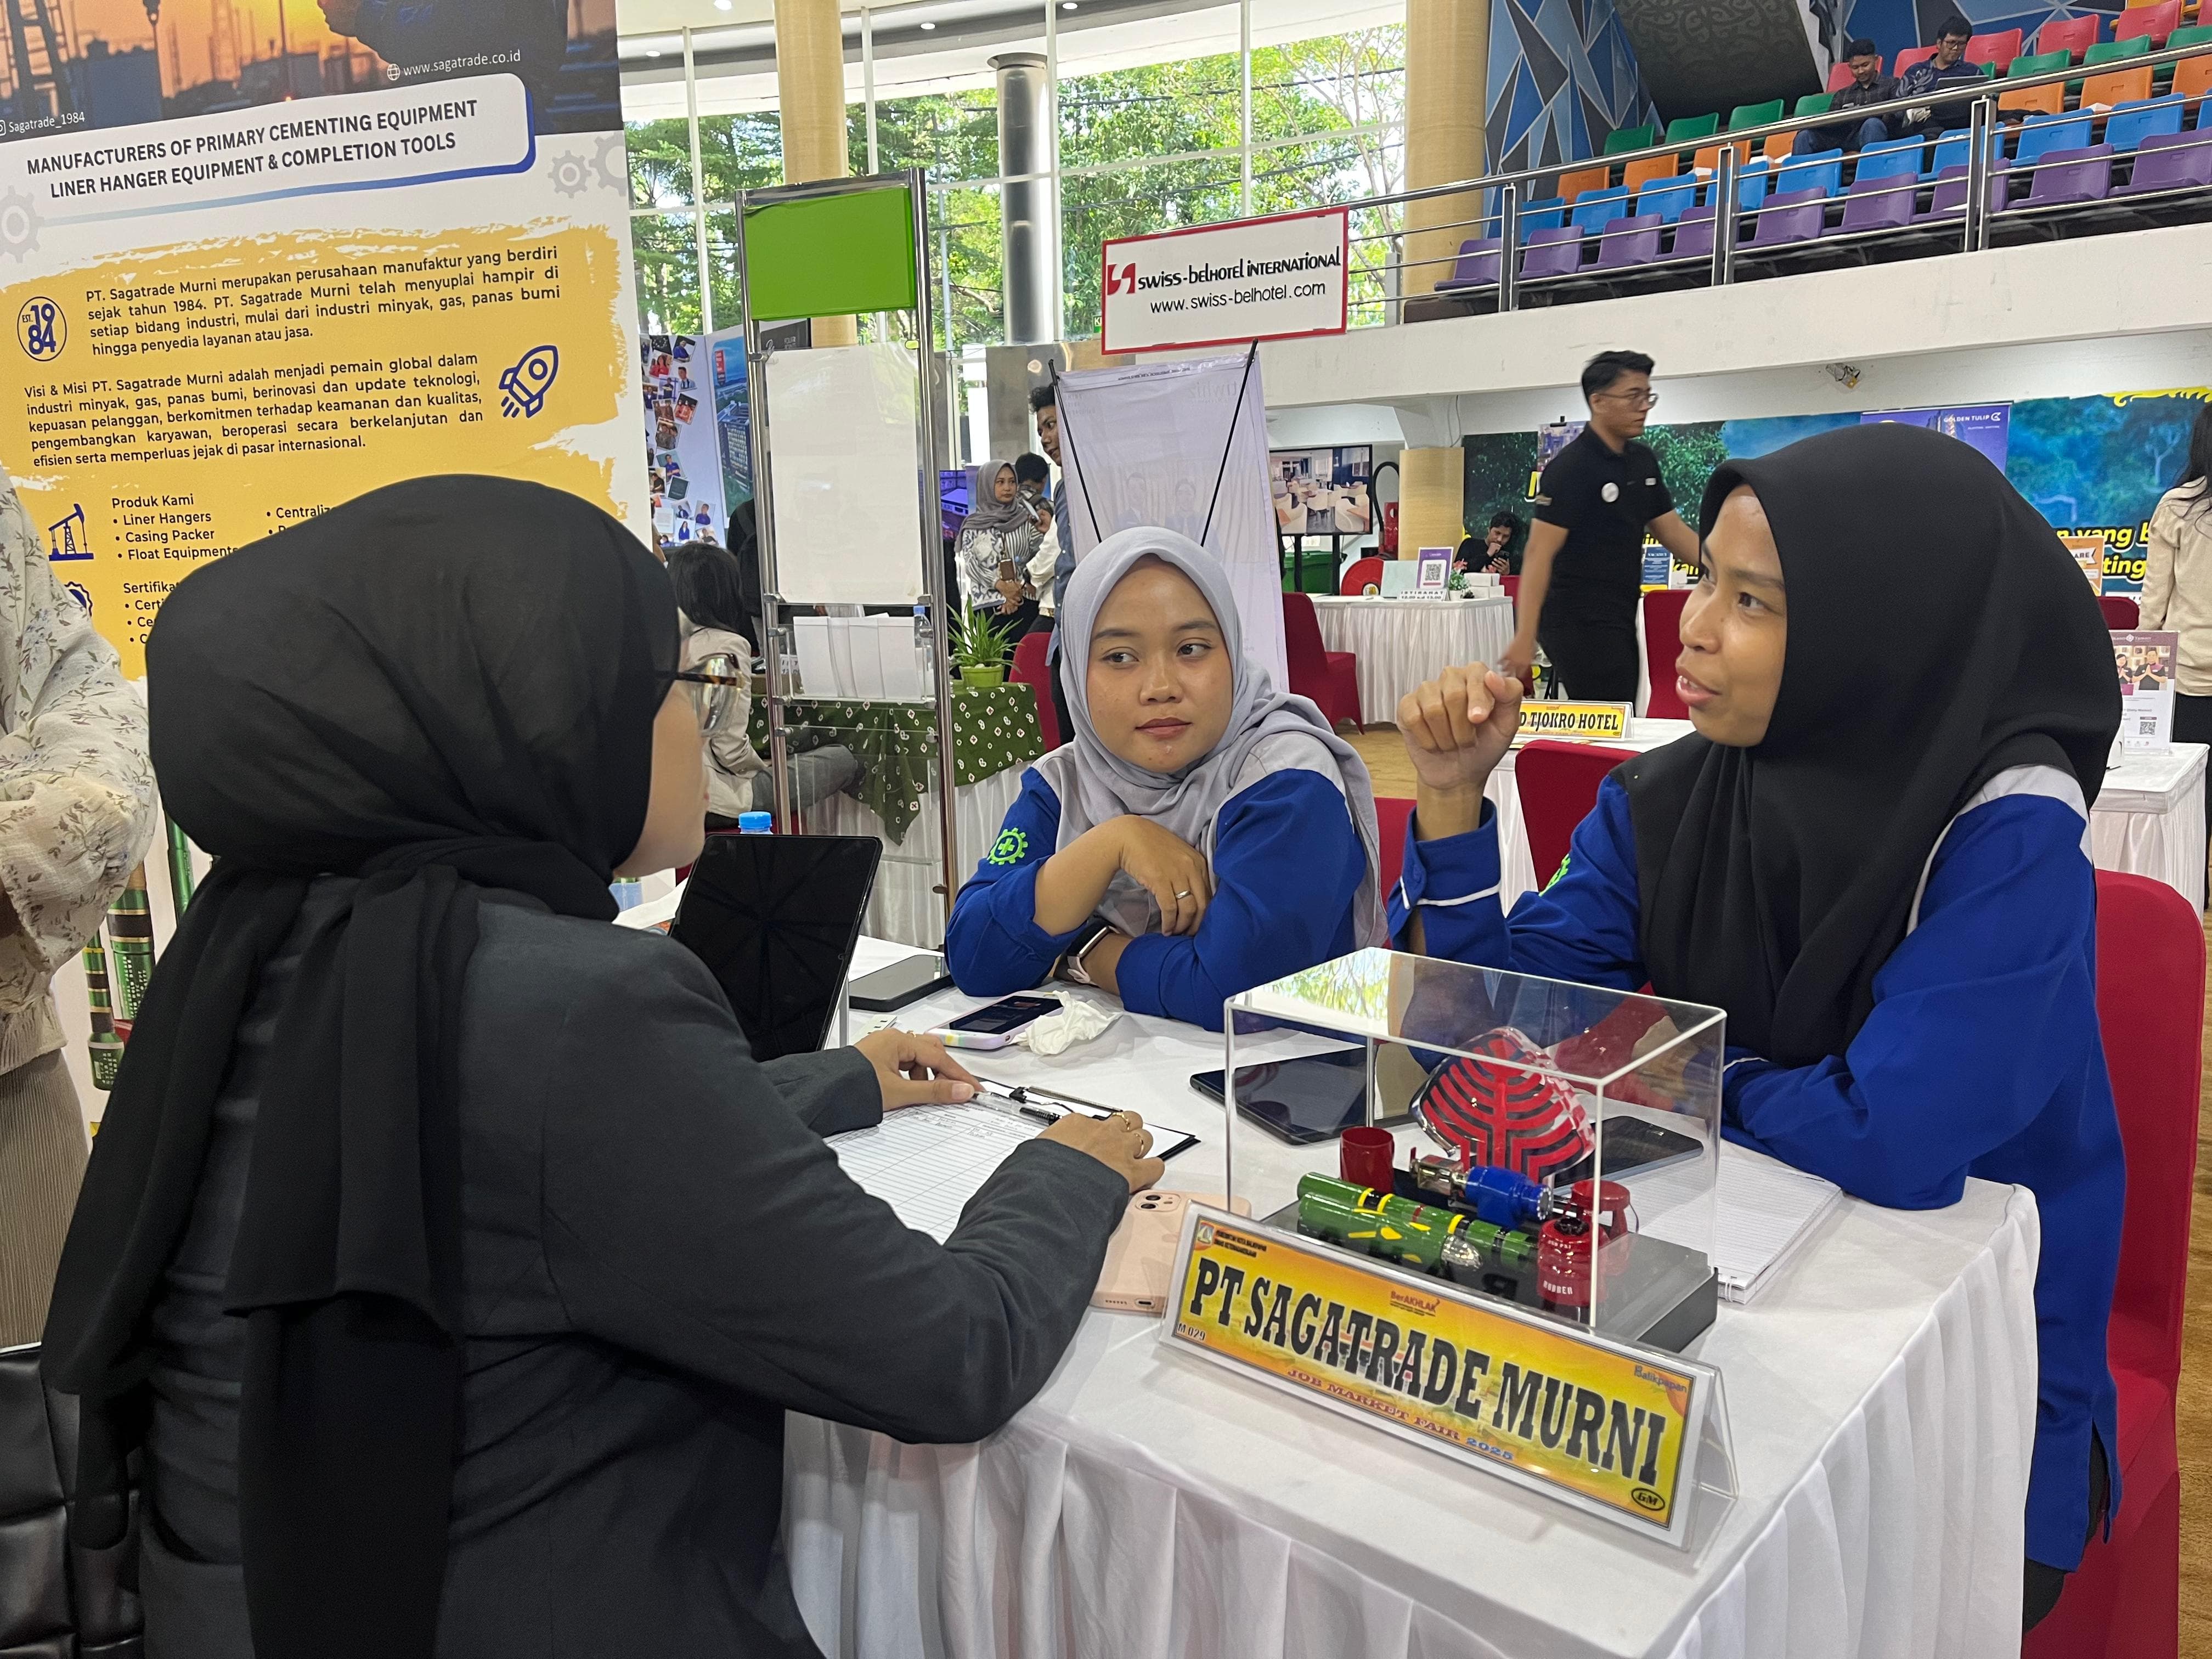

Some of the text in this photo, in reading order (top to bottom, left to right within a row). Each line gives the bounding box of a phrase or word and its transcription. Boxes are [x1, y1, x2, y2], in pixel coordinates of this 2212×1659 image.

[403, 49, 521, 76] www.sagatrade.co.id
[9, 111, 85, 134] Sagatrade_1984
[27, 99, 477, 175] MANUFACTURERS OF PRIMARY CEMENTING EQUIPMENT
[50, 132, 456, 198] LINER HANGER EQUIPMENT & COMPLETION TOOLS
[86, 245, 557, 302] PT. Sagatrade Murni merupakan perusahaan manufaktur yang berdiri
[88, 265, 558, 323] sejak tahun 1984. PT. Sagatrade Murni telah menyuplai hampir di
[90, 285, 560, 338] setiap bidang industri, mulai dari industri minyak, gas, panas bumi
[92, 325, 313, 357] hingga penyedia layanan atau jasa.
[24, 353, 478, 398] Visi & Misi PT. Sagatrade Murni adalah menjadi pemain global dalam
[26, 370, 480, 416] industri minyak, gas, panas bumi, berinovasi dan update teknologi,
[29, 391, 482, 435] kepuasan pelanggan, berkomitmen terhadap keamanan dan kualitas,
[31, 409, 483, 453] pengembangkan karyawan, beroperasi secara berkelanjutan dan
[33, 435, 366, 467] efisien serta memperluas jejak di pasar internasional.
[111, 493, 194, 509] Produk Kami
[123, 512, 212, 526] Liner Hangers
[125, 528, 215, 544] Casing Packer
[127, 548, 160, 560] Float
[1530, 712, 1576, 732] TJOKRO
[1578, 714, 1618, 730] HOTEL
[1189, 1258, 1666, 1487] PT SAGATRADE MURNI
[1287, 1368, 1514, 1461] JOB MARKET FAIR 2025
